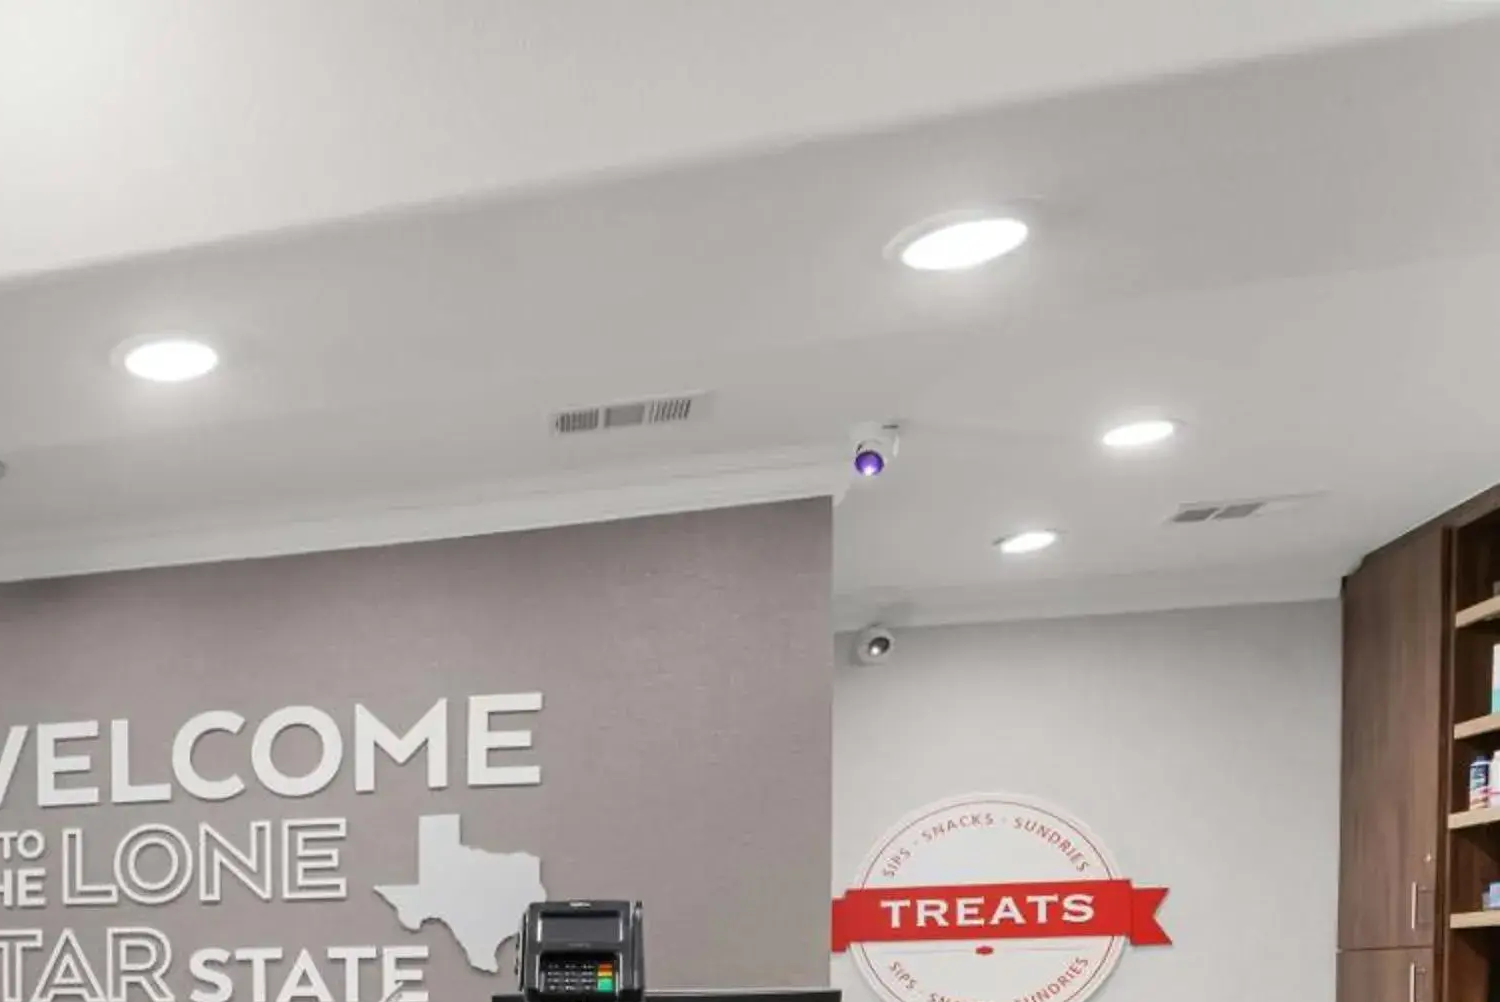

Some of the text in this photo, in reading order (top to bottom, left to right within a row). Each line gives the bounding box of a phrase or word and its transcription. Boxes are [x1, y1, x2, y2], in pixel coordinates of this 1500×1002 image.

[61, 817, 348, 906] LONE
[882, 812, 1090, 879] SIPS SNACKS SUNDRIES
[880, 893, 1096, 929] TREATS
[888, 960, 919, 991] SIPS
